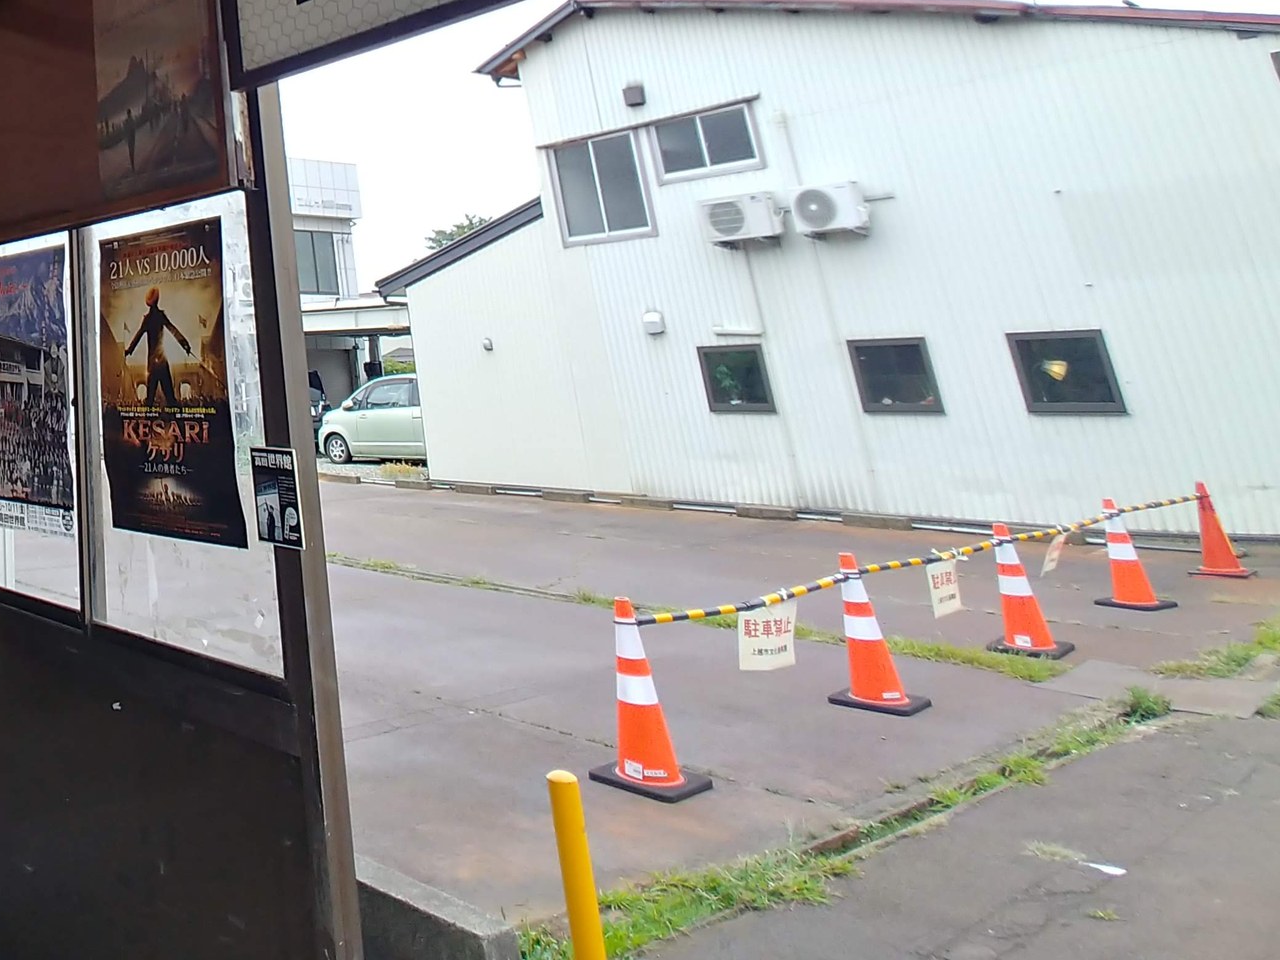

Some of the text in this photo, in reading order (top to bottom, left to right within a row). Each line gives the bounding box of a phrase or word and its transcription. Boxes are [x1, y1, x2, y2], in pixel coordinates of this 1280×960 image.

[123, 420, 210, 447] KESARI
[146, 441, 184, 463] ケサリ
[743, 616, 792, 638] 駐車禁止
